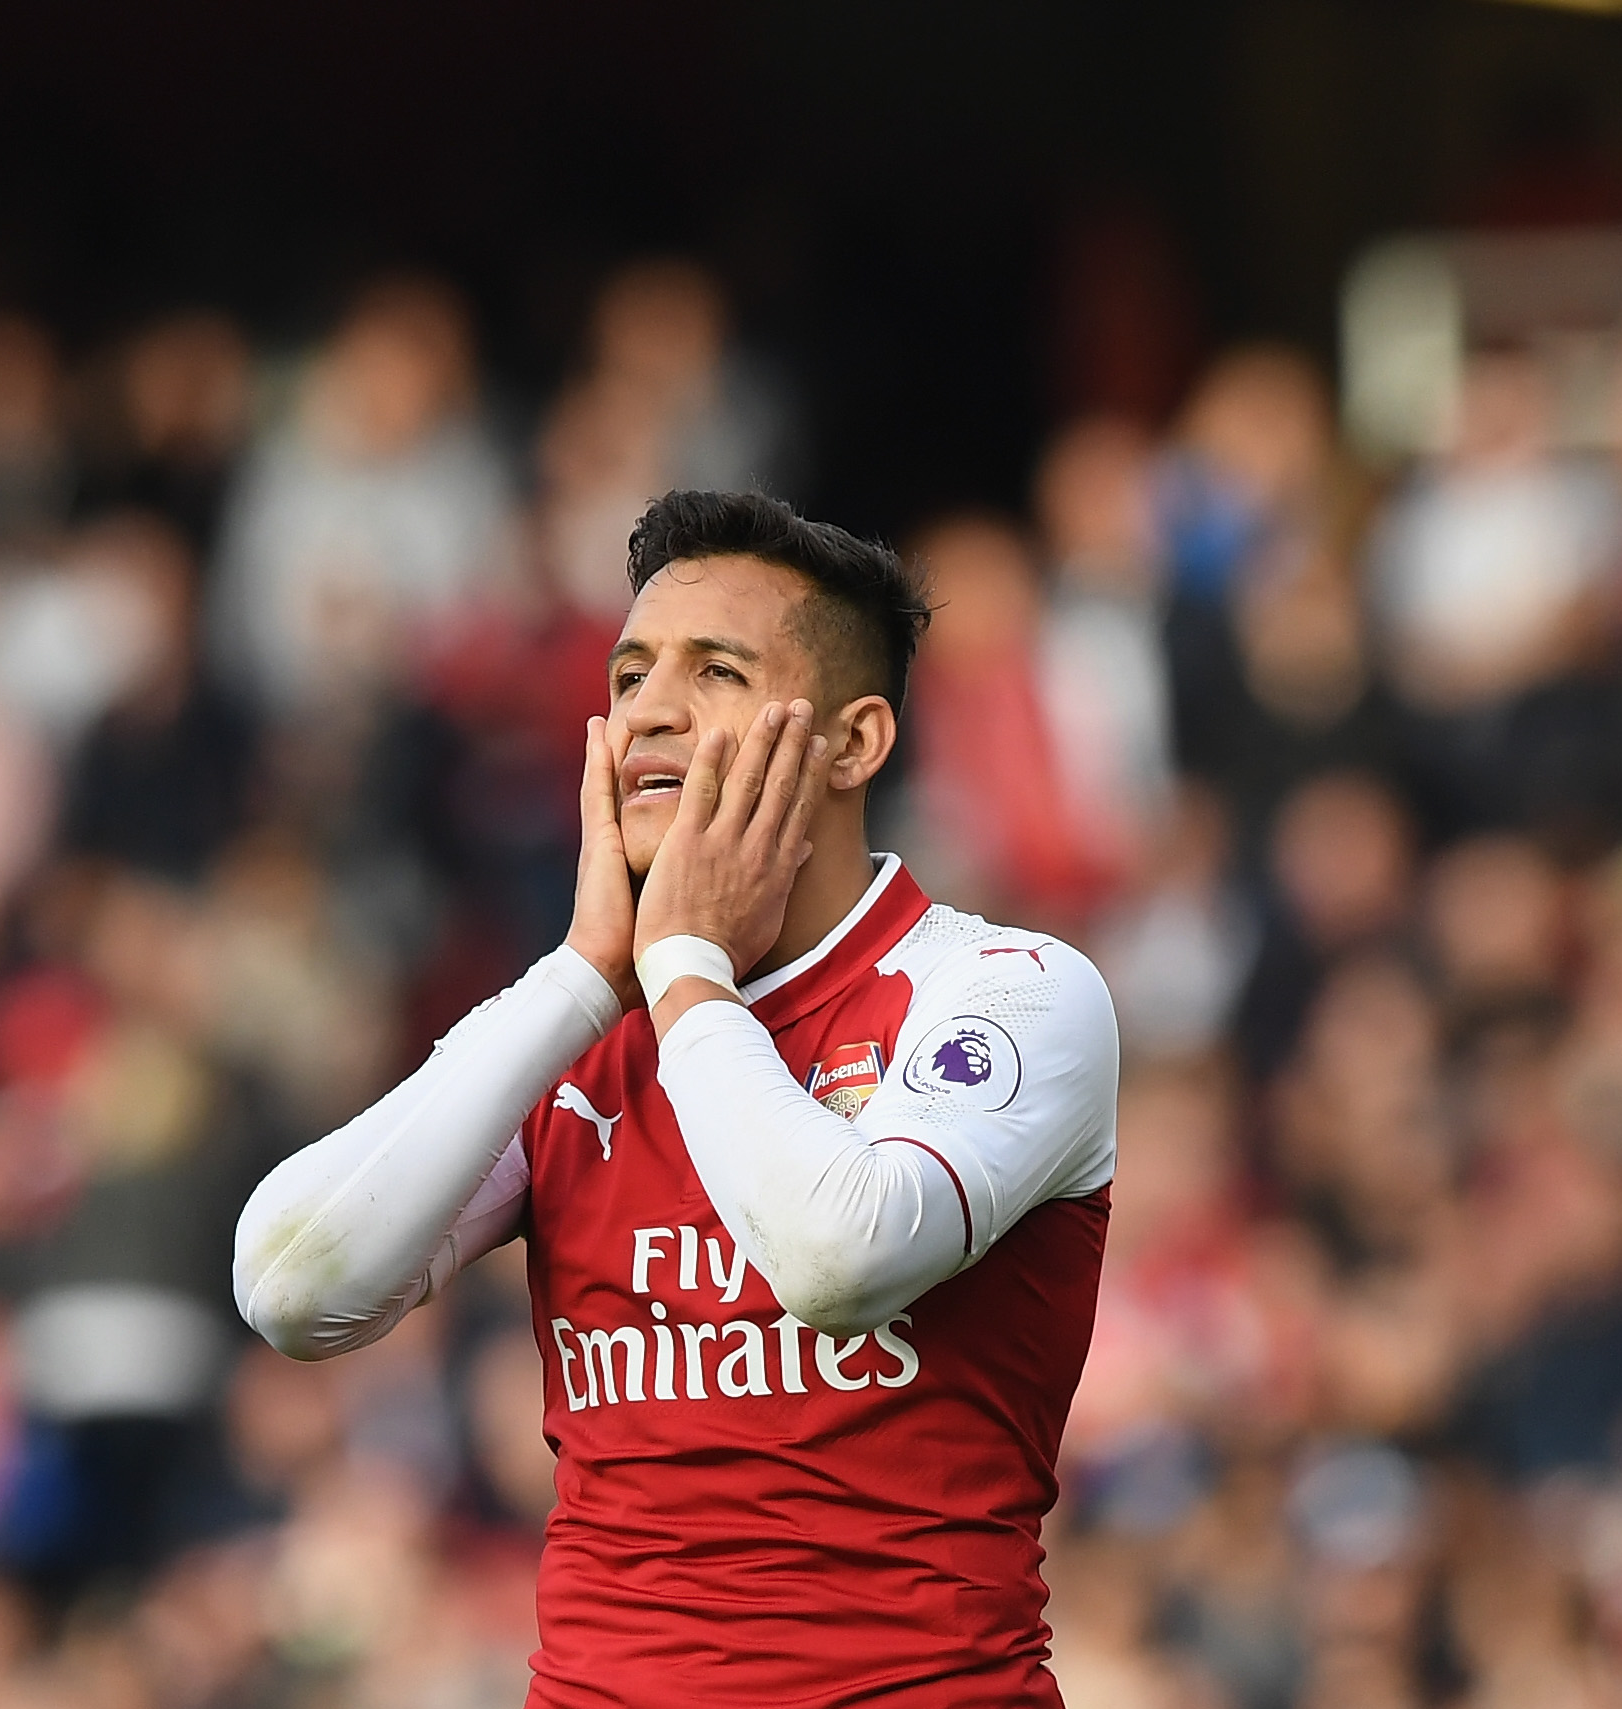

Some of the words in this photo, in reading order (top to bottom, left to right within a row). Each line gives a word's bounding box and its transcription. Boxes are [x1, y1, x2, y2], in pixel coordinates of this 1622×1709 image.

[816, 1055, 875, 1089] Arsenal
[632, 1225, 748, 1303] Fly
[551, 1301, 920, 1412] Emirates
